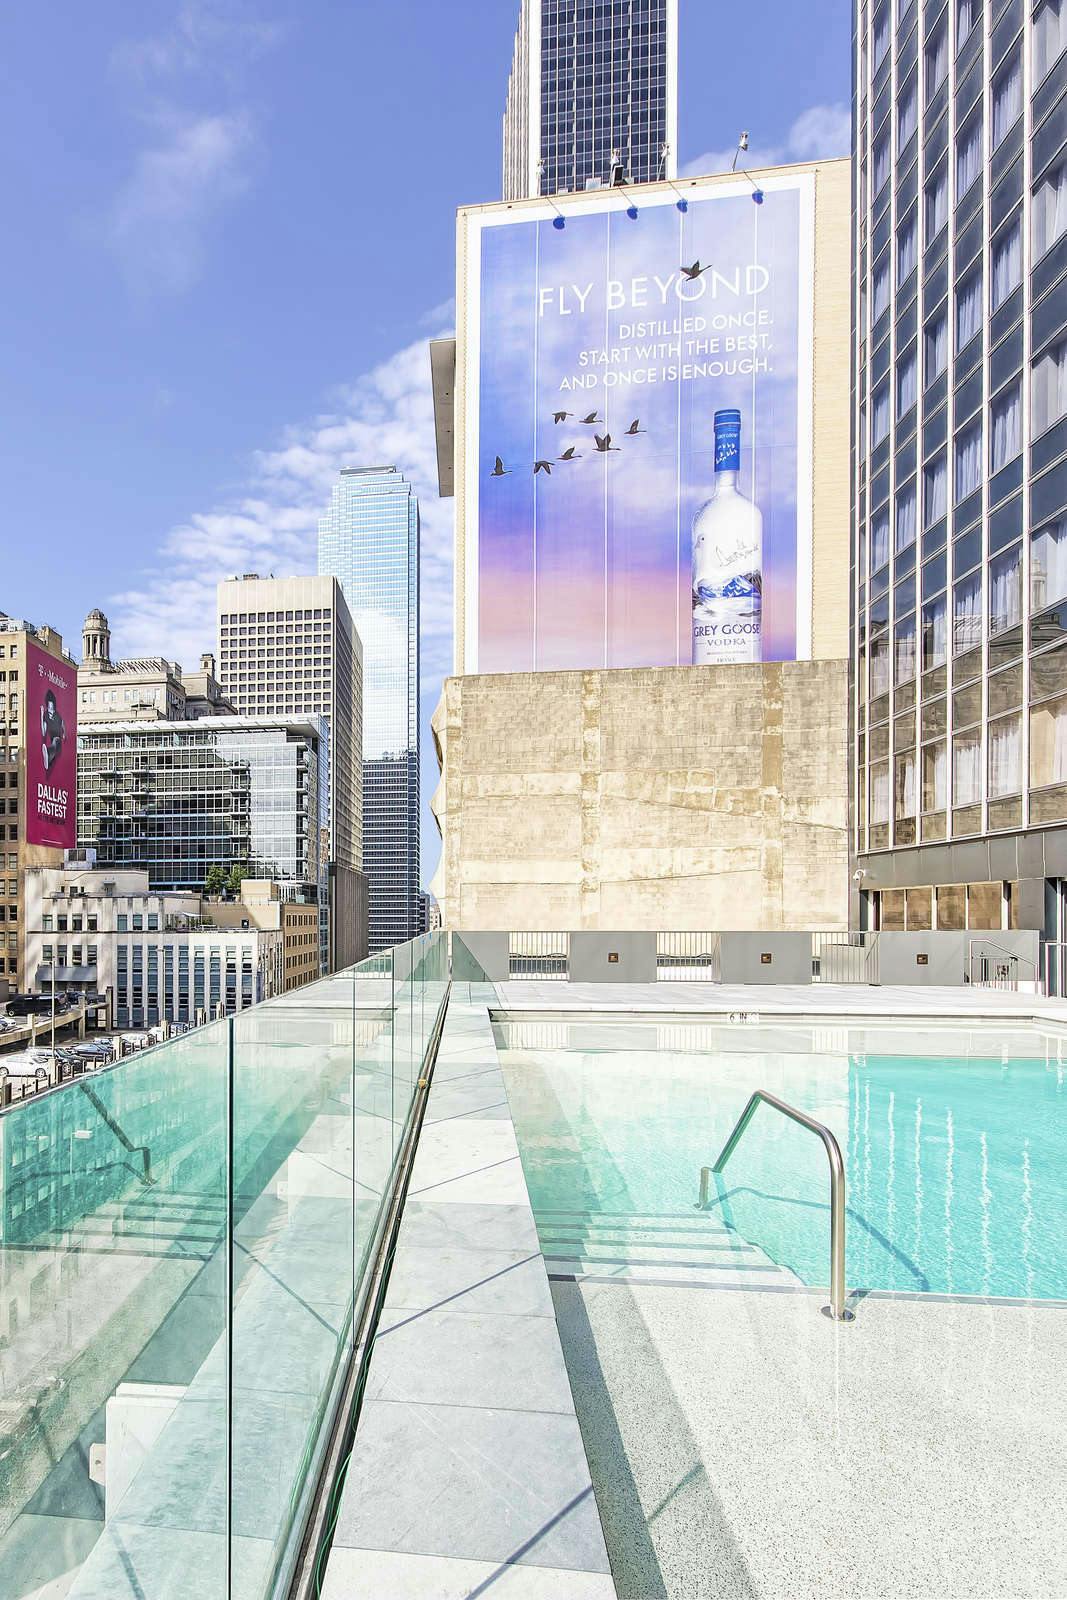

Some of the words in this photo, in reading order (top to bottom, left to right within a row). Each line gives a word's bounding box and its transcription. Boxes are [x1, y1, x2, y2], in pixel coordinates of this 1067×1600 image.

[539, 282, 594, 317] FLY
[607, 265, 770, 310] BEYOND
[619, 316, 706, 340] DISTILLED
[712, 310, 774, 330] ONCE.
[578, 346, 631, 367] START
[635, 341, 681, 361] WITH
[685, 338, 720, 356] THE
[725, 333, 773, 353] BEST,
[559, 373, 598, 391] AND
[603, 367, 657, 387] ONCE
[662, 364, 678, 382] IS
[682, 357, 773, 380] ENOUGH.
[694, 625, 718, 638] GREY
[721, 623, 760, 636] GOOSE
[707, 638, 747, 647] VODKA
[37, 799, 67, 819] FASTEST
